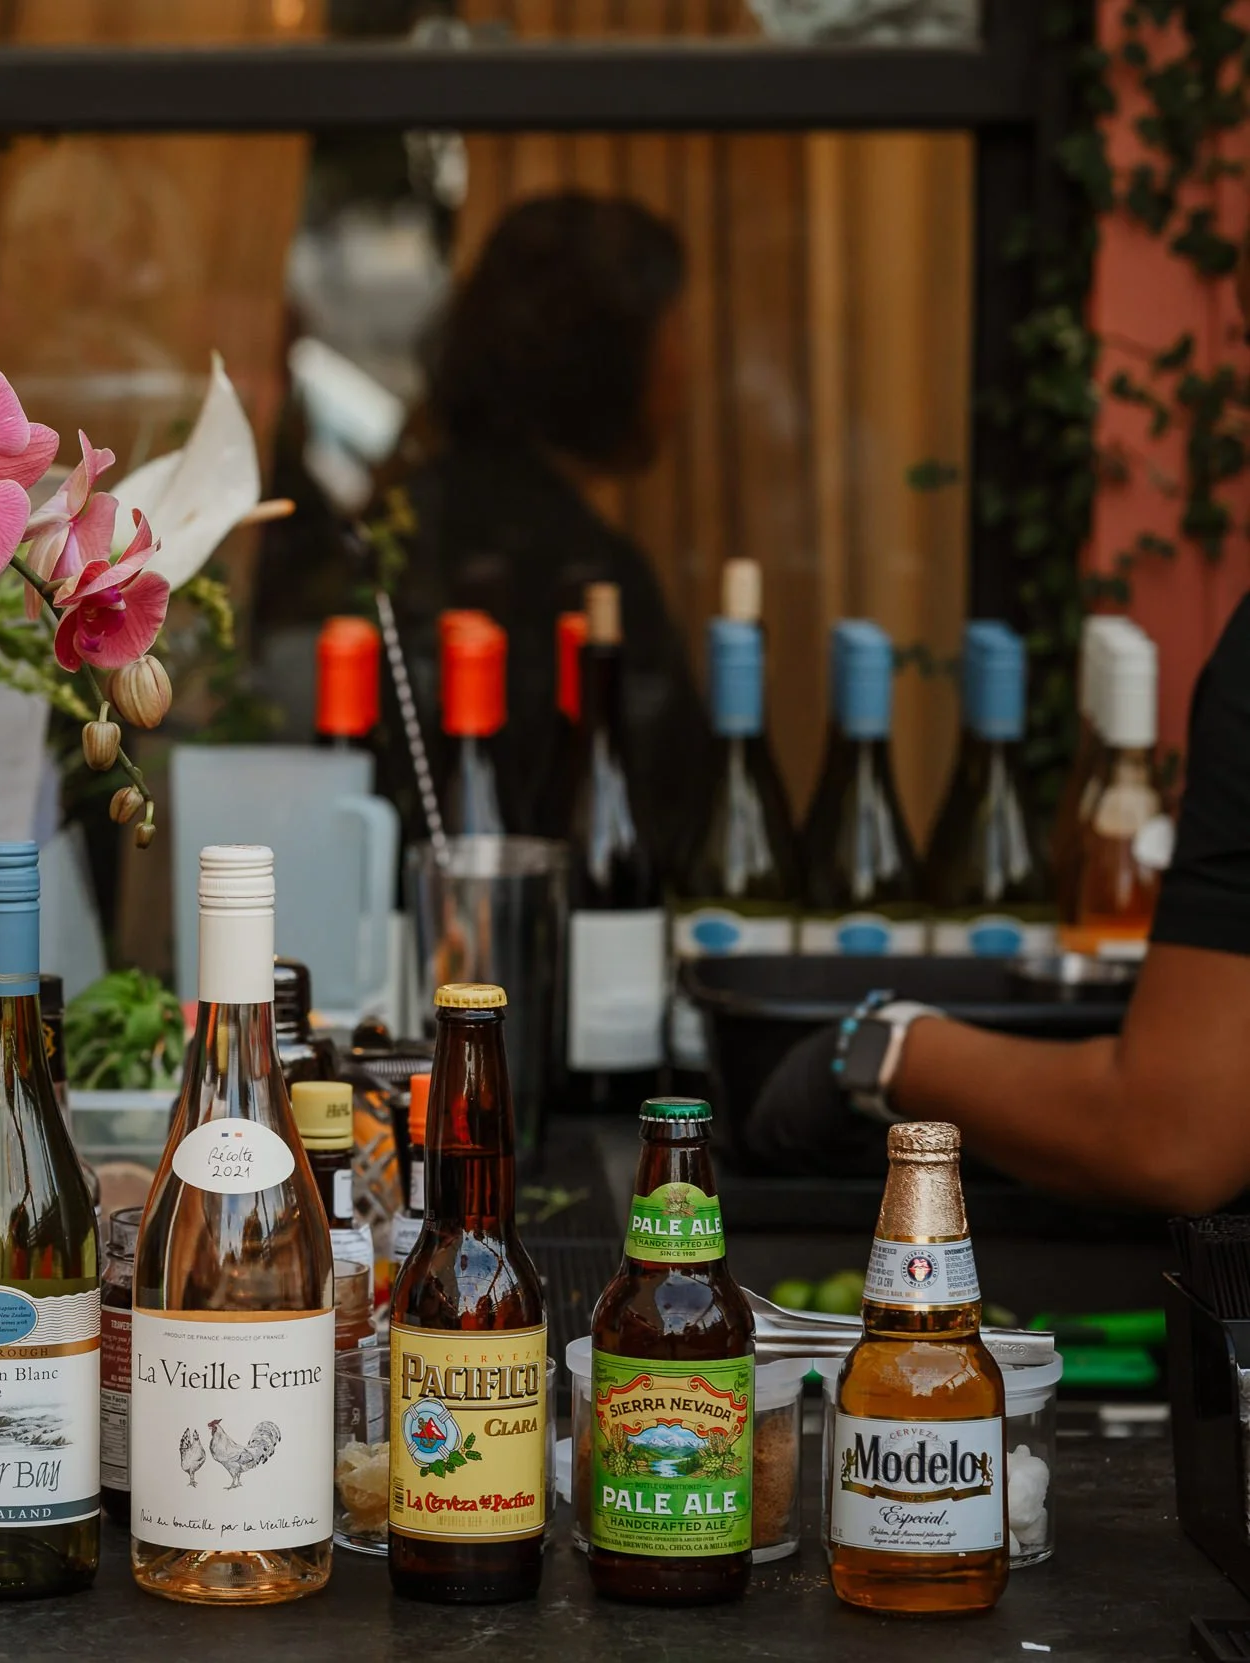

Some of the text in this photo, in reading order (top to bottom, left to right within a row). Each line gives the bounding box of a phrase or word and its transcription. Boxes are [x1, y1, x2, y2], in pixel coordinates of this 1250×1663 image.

[208, 1145, 254, 1164] Récolte
[212, 1166, 250, 1178] 2021
[632, 1216, 722, 1235] PALE ALE
[639, 1239, 701, 1247] HANDCRAFTED
[446, 1350, 539, 1363] CERVEZA
[16, 1367, 58, 1381] Blanc
[138, 1354, 322, 1390] La Vieille Ferme
[402, 1352, 540, 1400] PACIFICO
[609, 1397, 732, 1422] SIERRA NEVADA
[484, 1417, 538, 1436] CLARA
[889, 1428, 939, 1441] CERVEZA
[854, 1432, 976, 1485] Modelo
[13, 1459, 62, 1492] Bay
[425, 1492, 478, 1513] Cerveza
[479, 1495, 491, 1509] del
[603, 1485, 737, 1515] PALE ALE
[157, 1518, 168, 1526] en
[173, 1517, 215, 1530] bouteille
[221, 1523, 238, 1537] par
[611, 1517, 726, 1532] HANDCRAFTED ALE
[622, 1541, 653, 1550] BREWING
